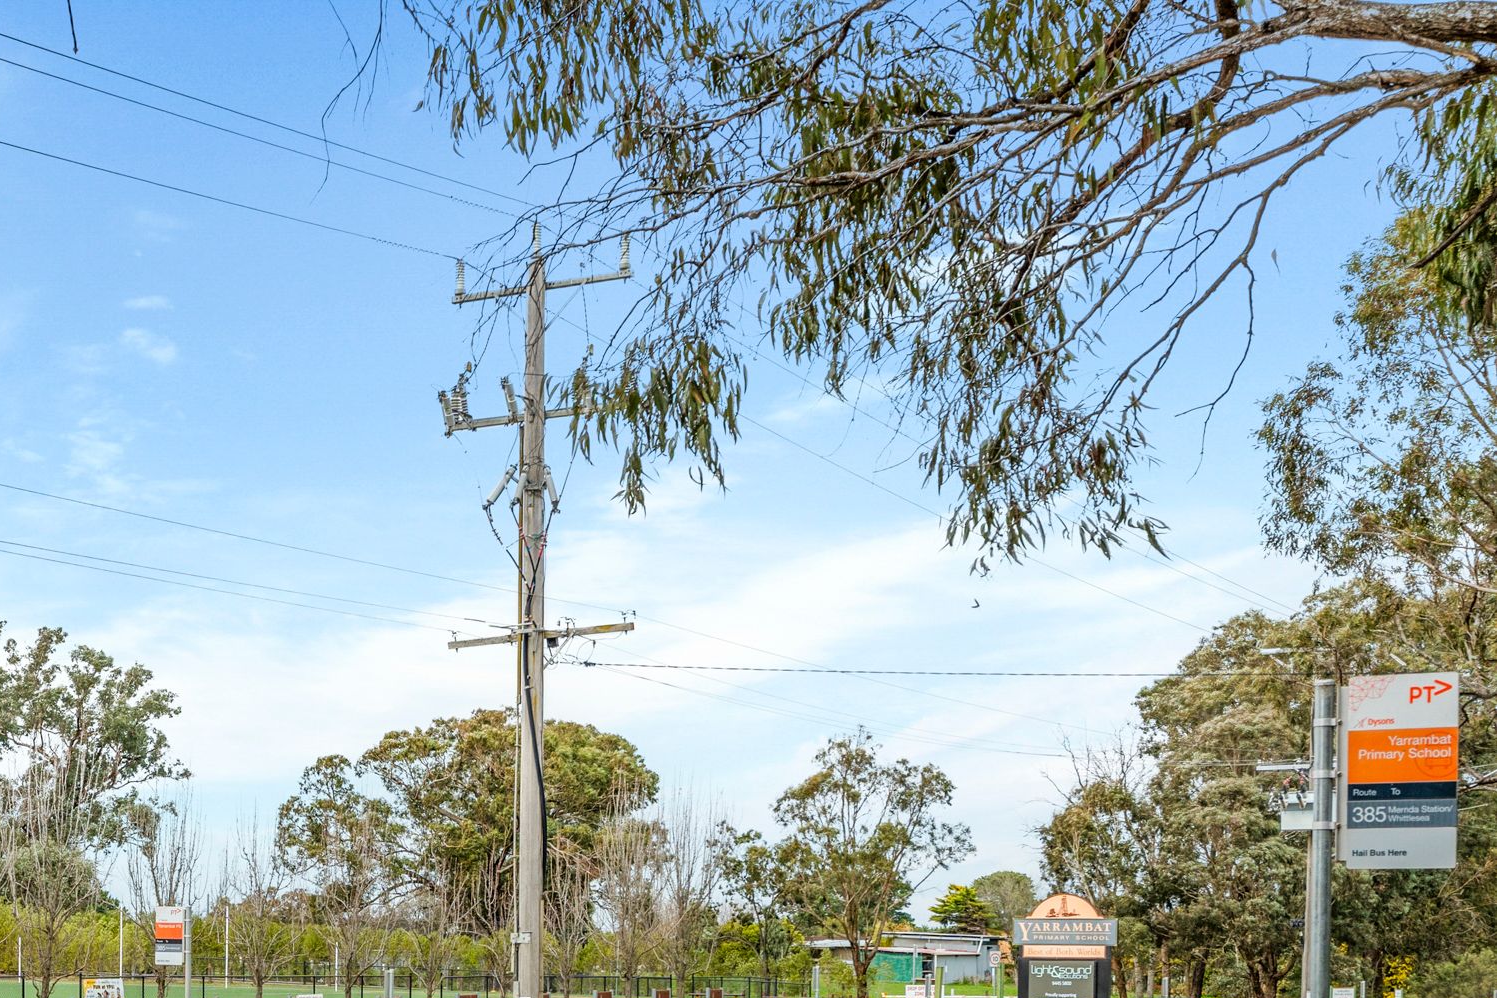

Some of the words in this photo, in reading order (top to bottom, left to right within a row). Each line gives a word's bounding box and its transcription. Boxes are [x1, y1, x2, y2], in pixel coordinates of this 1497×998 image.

[1367, 718, 1395, 727] Dysons
[1388, 734, 1452, 746] Yarrambat
[1358, 749, 1405, 761] Primary
[1408, 747, 1452, 759] School
[1352, 788, 1378, 797] Route
[1391, 787, 1402, 796] To
[1352, 806, 1387, 823] 385
[1388, 805, 1419, 814] Mernda
[1388, 814, 1431, 822] Whittlesea
[1352, 849, 1368, 857] Hail
[1369, 849, 1386, 857] Bus
[1387, 849, 1408, 857] Here
[1018, 922, 1112, 941] YARRAMBAT
[1056, 947, 1073, 955] Both
[1077, 947, 1101, 956] Worlds
